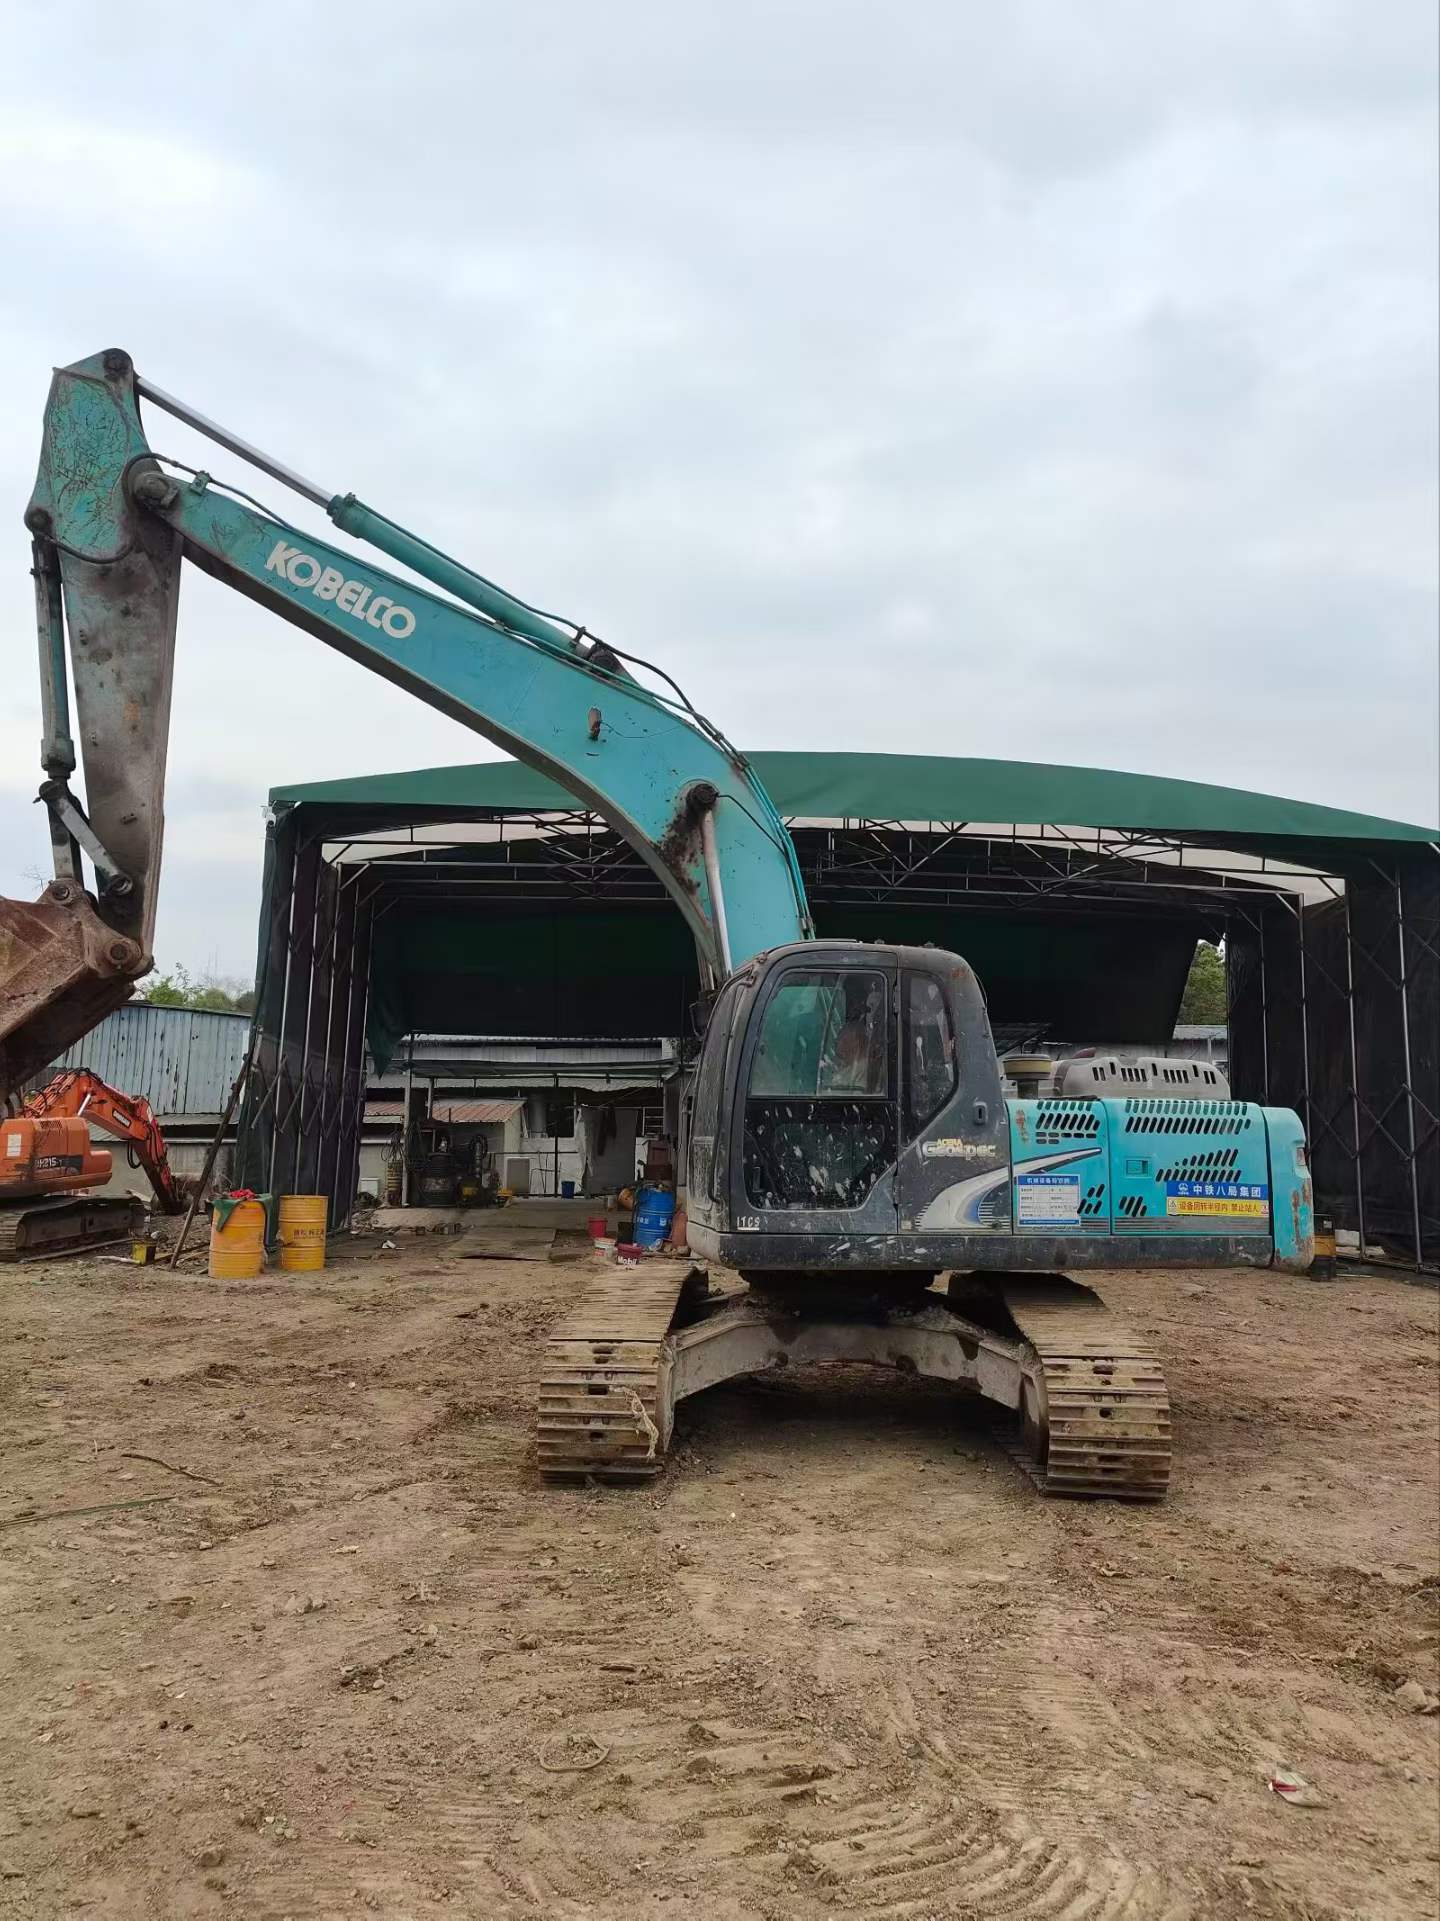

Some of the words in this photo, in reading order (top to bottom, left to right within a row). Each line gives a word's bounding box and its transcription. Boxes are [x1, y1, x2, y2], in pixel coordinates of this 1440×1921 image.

[265, 540, 416, 639] KOBELCO
[1193, 1185, 1261, 1198] 中铁八局集团
[736, 1215, 760, 1228] ITCS
